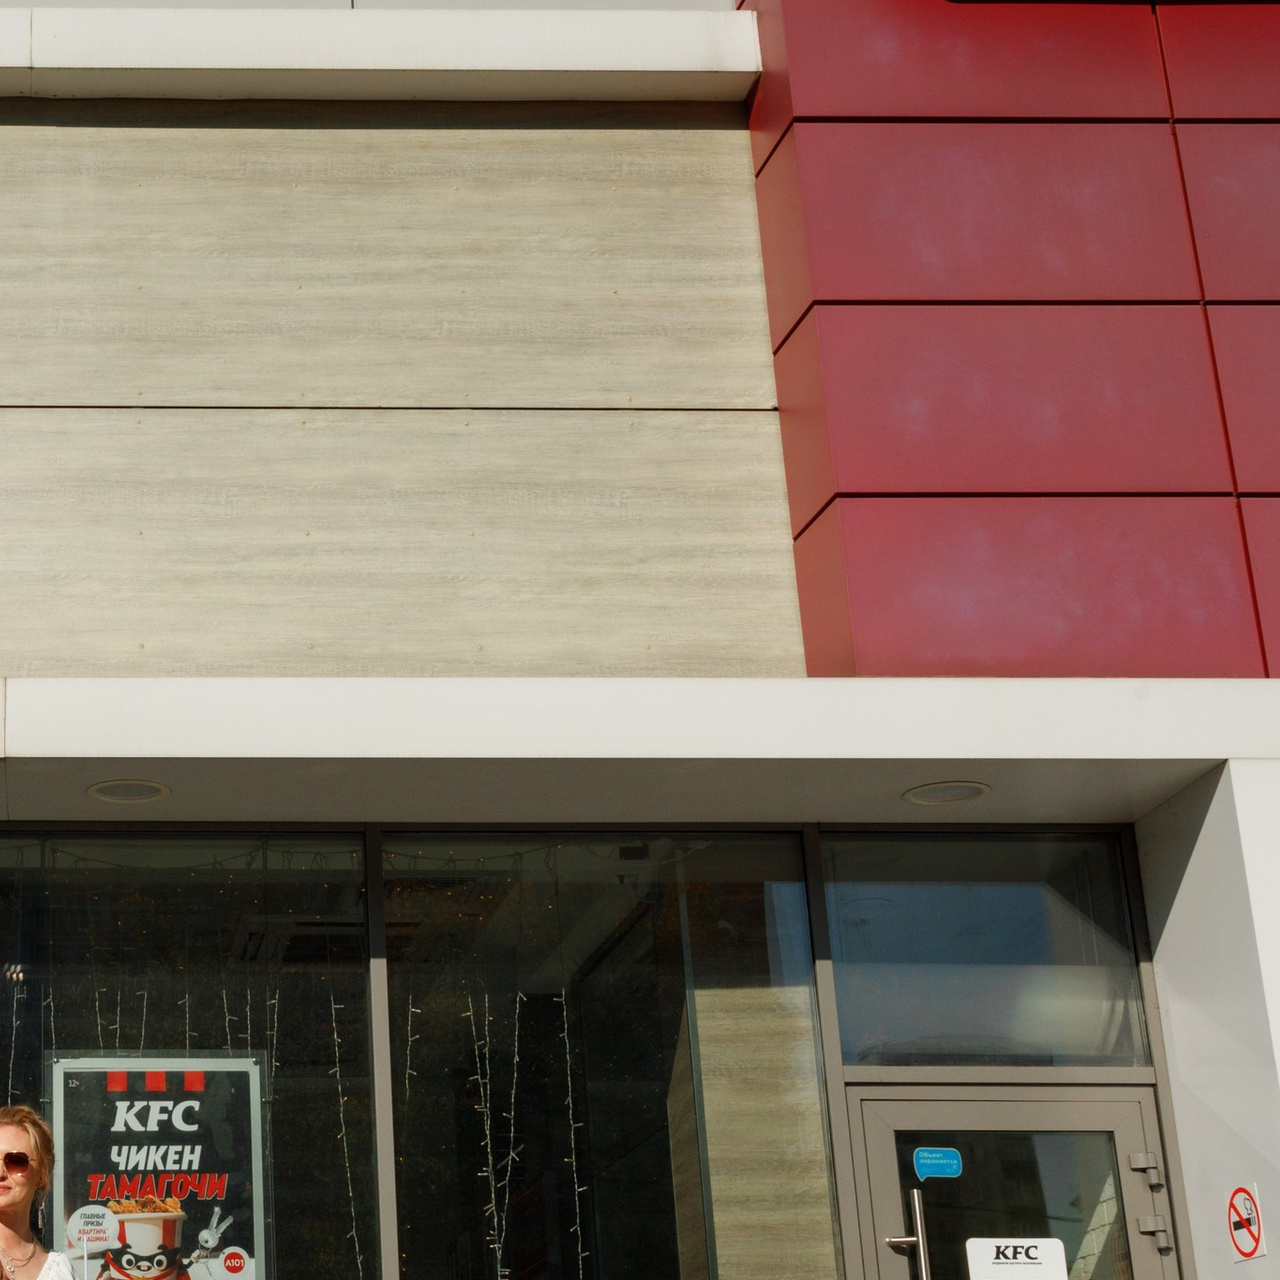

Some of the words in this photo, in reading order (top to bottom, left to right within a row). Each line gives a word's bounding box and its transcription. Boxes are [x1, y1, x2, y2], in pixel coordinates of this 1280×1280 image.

[110, 1100, 200, 1132] KFC
[110, 1145, 202, 1171] ЧИКЕН
[87, 1173, 229, 1200] ТАМАГОЧИ
[80, 1212, 106, 1220] ГЛАВНЫЕ
[994, 1245, 1038, 1260] KFC
